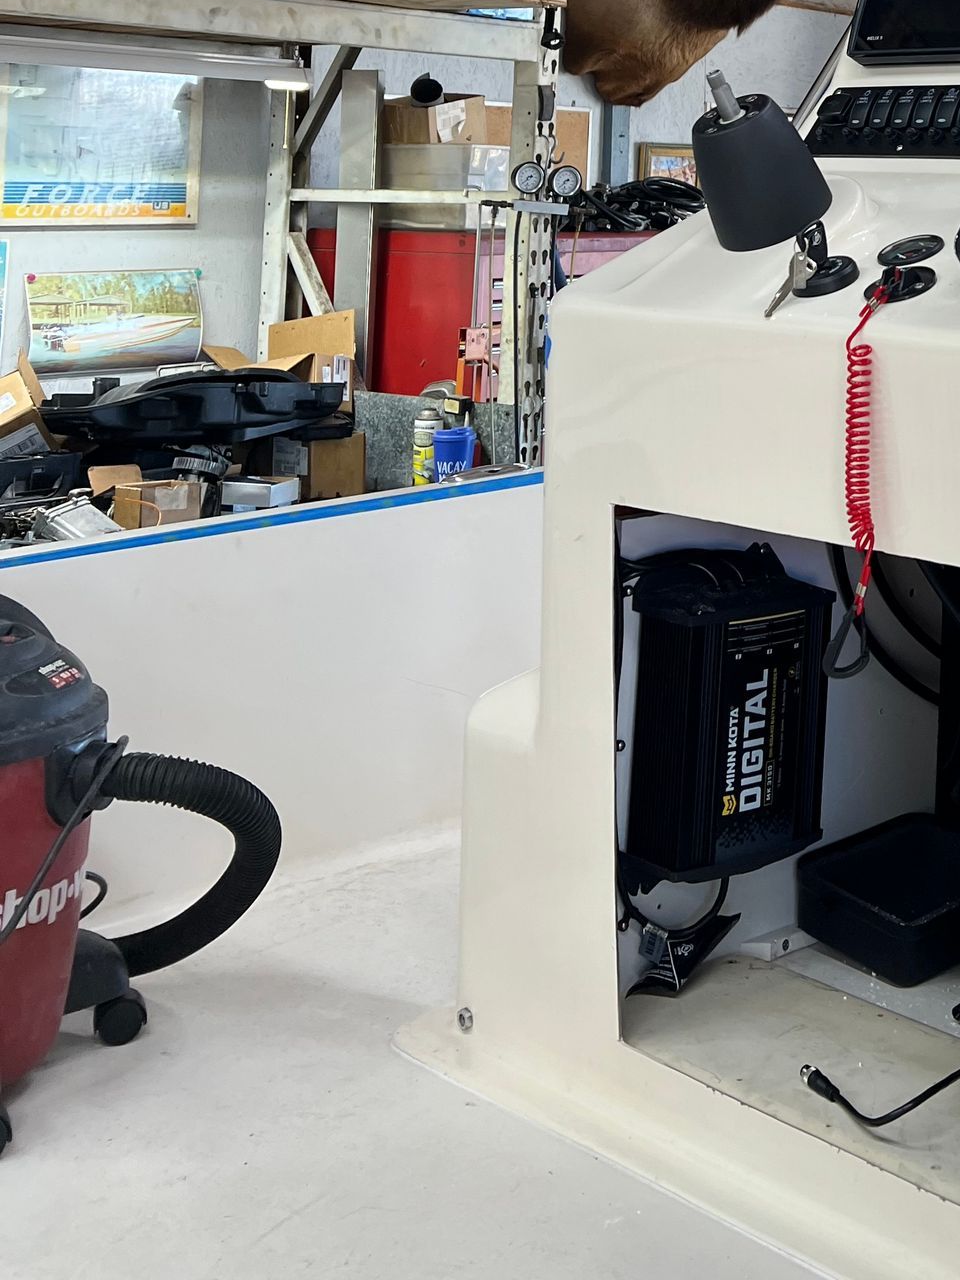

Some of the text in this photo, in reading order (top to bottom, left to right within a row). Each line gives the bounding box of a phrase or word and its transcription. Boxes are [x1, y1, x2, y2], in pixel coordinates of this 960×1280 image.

[20, 183, 151, 206] FORCE
[16, 204, 141, 217] OUTBOARDS
[436, 460, 467, 474] VACAY
[725, 707, 740, 792] MINN KOTA
[738, 668, 769, 813] DIGITAL
